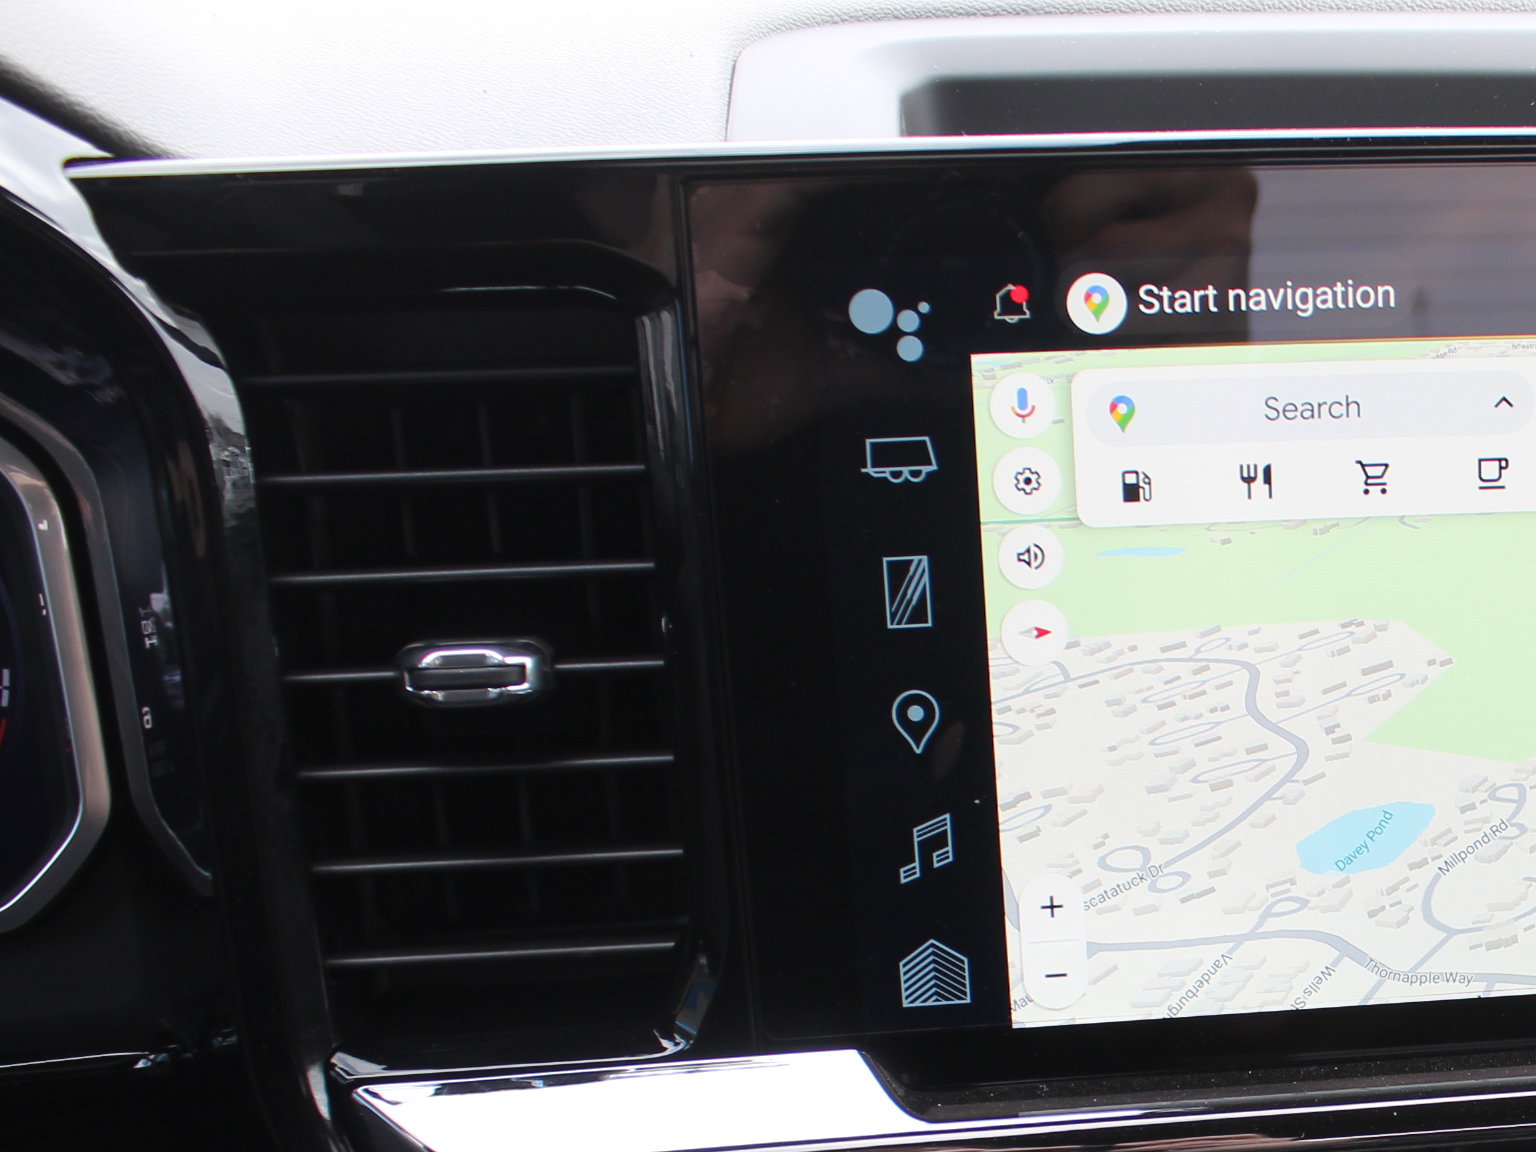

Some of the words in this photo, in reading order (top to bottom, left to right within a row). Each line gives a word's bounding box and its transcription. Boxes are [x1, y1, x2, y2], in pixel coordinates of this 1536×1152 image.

[1138, 283, 1218, 315] Start
[1228, 280, 1396, 318] navigation
[1263, 394, 1362, 423] Search
[1334, 840, 1370, 873] Davey
[1365, 809, 1394, 843] Pond
[1437, 834, 1491, 877] Millpond
[1489, 818, 1509, 839] Rd
[1146, 863, 1165, 881] Dr
[1163, 953, 1233, 1019] Vanderburg
[1302, 965, 1336, 998] Wells
[1364, 957, 1441, 985] Thornapple
[1443, 971, 1474, 986] Way
